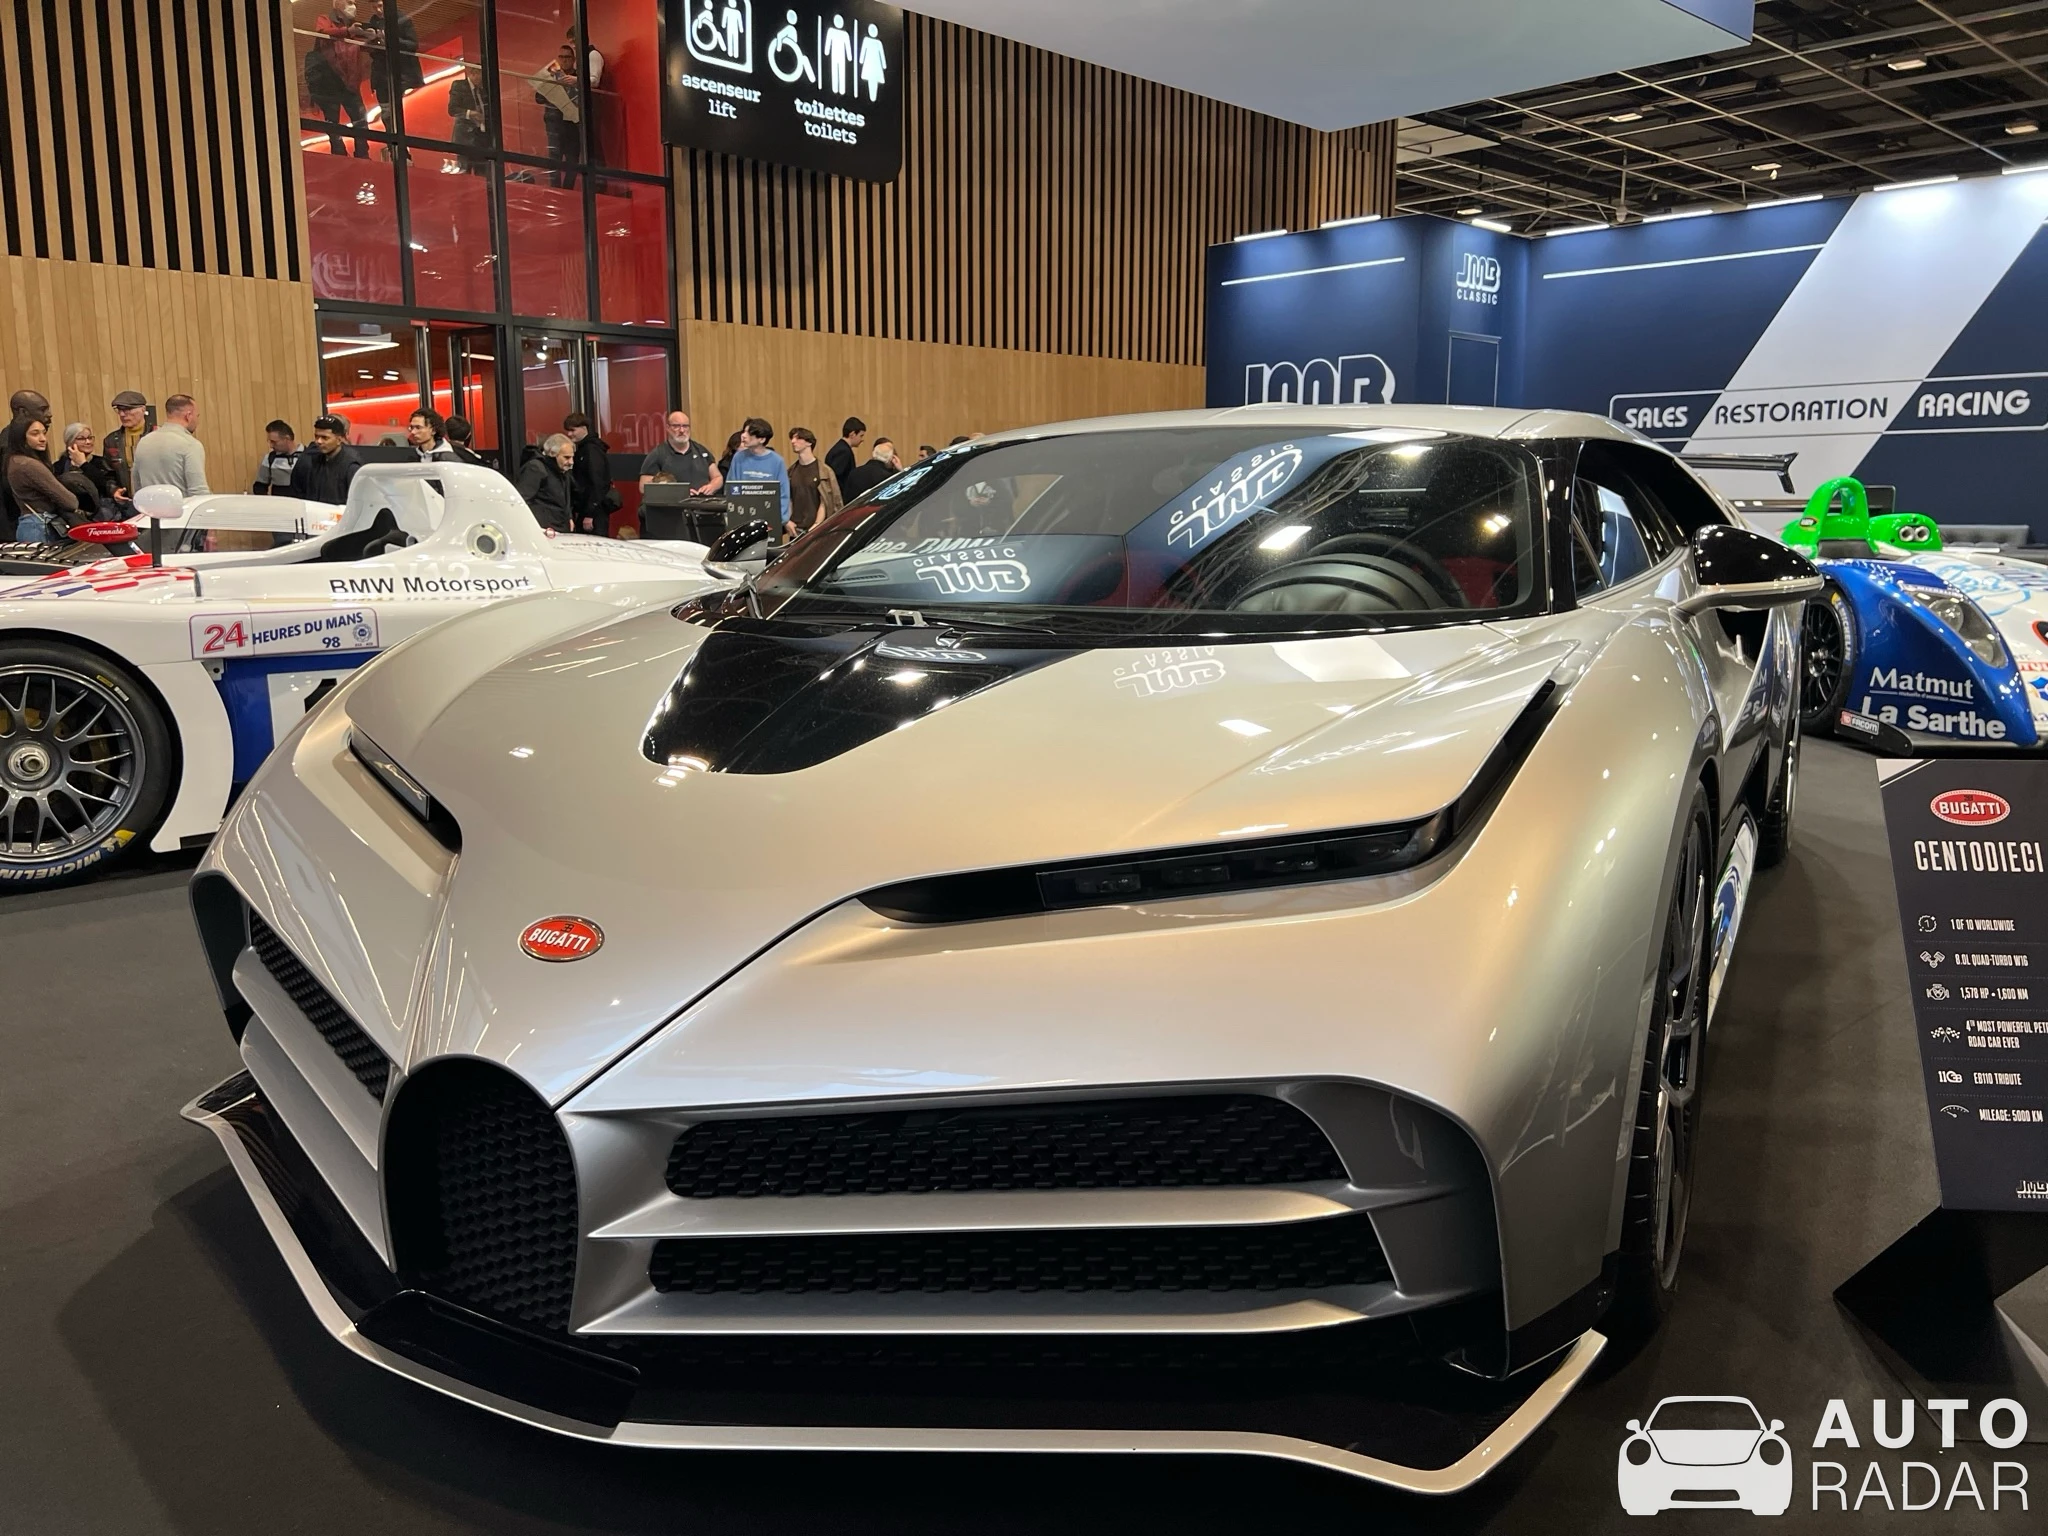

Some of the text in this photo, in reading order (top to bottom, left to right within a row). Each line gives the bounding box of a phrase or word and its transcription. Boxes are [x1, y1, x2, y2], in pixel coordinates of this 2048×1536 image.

[682, 73, 761, 103] ascenseur
[708, 98, 738, 119] lift
[794, 98, 866, 127] toilettes
[803, 120, 858, 145] toilets
[1456, 288, 1498, 305] CLASSIC
[1625, 389, 2031, 430] SALES RESTORATION RACING
[329, 576, 530, 594] BMW Motorsport
[203, 611, 363, 654] 24 HEURES DU MANS
[322, 636, 341, 649] 98
[1869, 666, 1974, 700] Matmut
[1861, 696, 2006, 740] La Sarthe
[1939, 801, 2001, 815] BUGATTI
[0, 849, 101, 880] MICHELIN
[1913, 840, 2044, 873] CENTODIECI
[1950, 919, 2016, 932] 1 OF 10 WORLDWIDE
[527, 927, 592, 952] BUGATTI
[1954, 953, 2029, 967] 8.0L QUAD-TURBO W16
[1959, 987, 2029, 1001] 1,578 HP 1,600 NM
[1976, 1020, 1996, 1033] MOST
[1996, 1020, 2034, 1034] POWERFUL
[1967, 1035, 2020, 1049] ROAD CAR EVER
[1973, 1072, 2022, 1086] EB110 TRIBUTE
[1979, 1108, 2044, 1123] MILEAGE: 5000 KM
